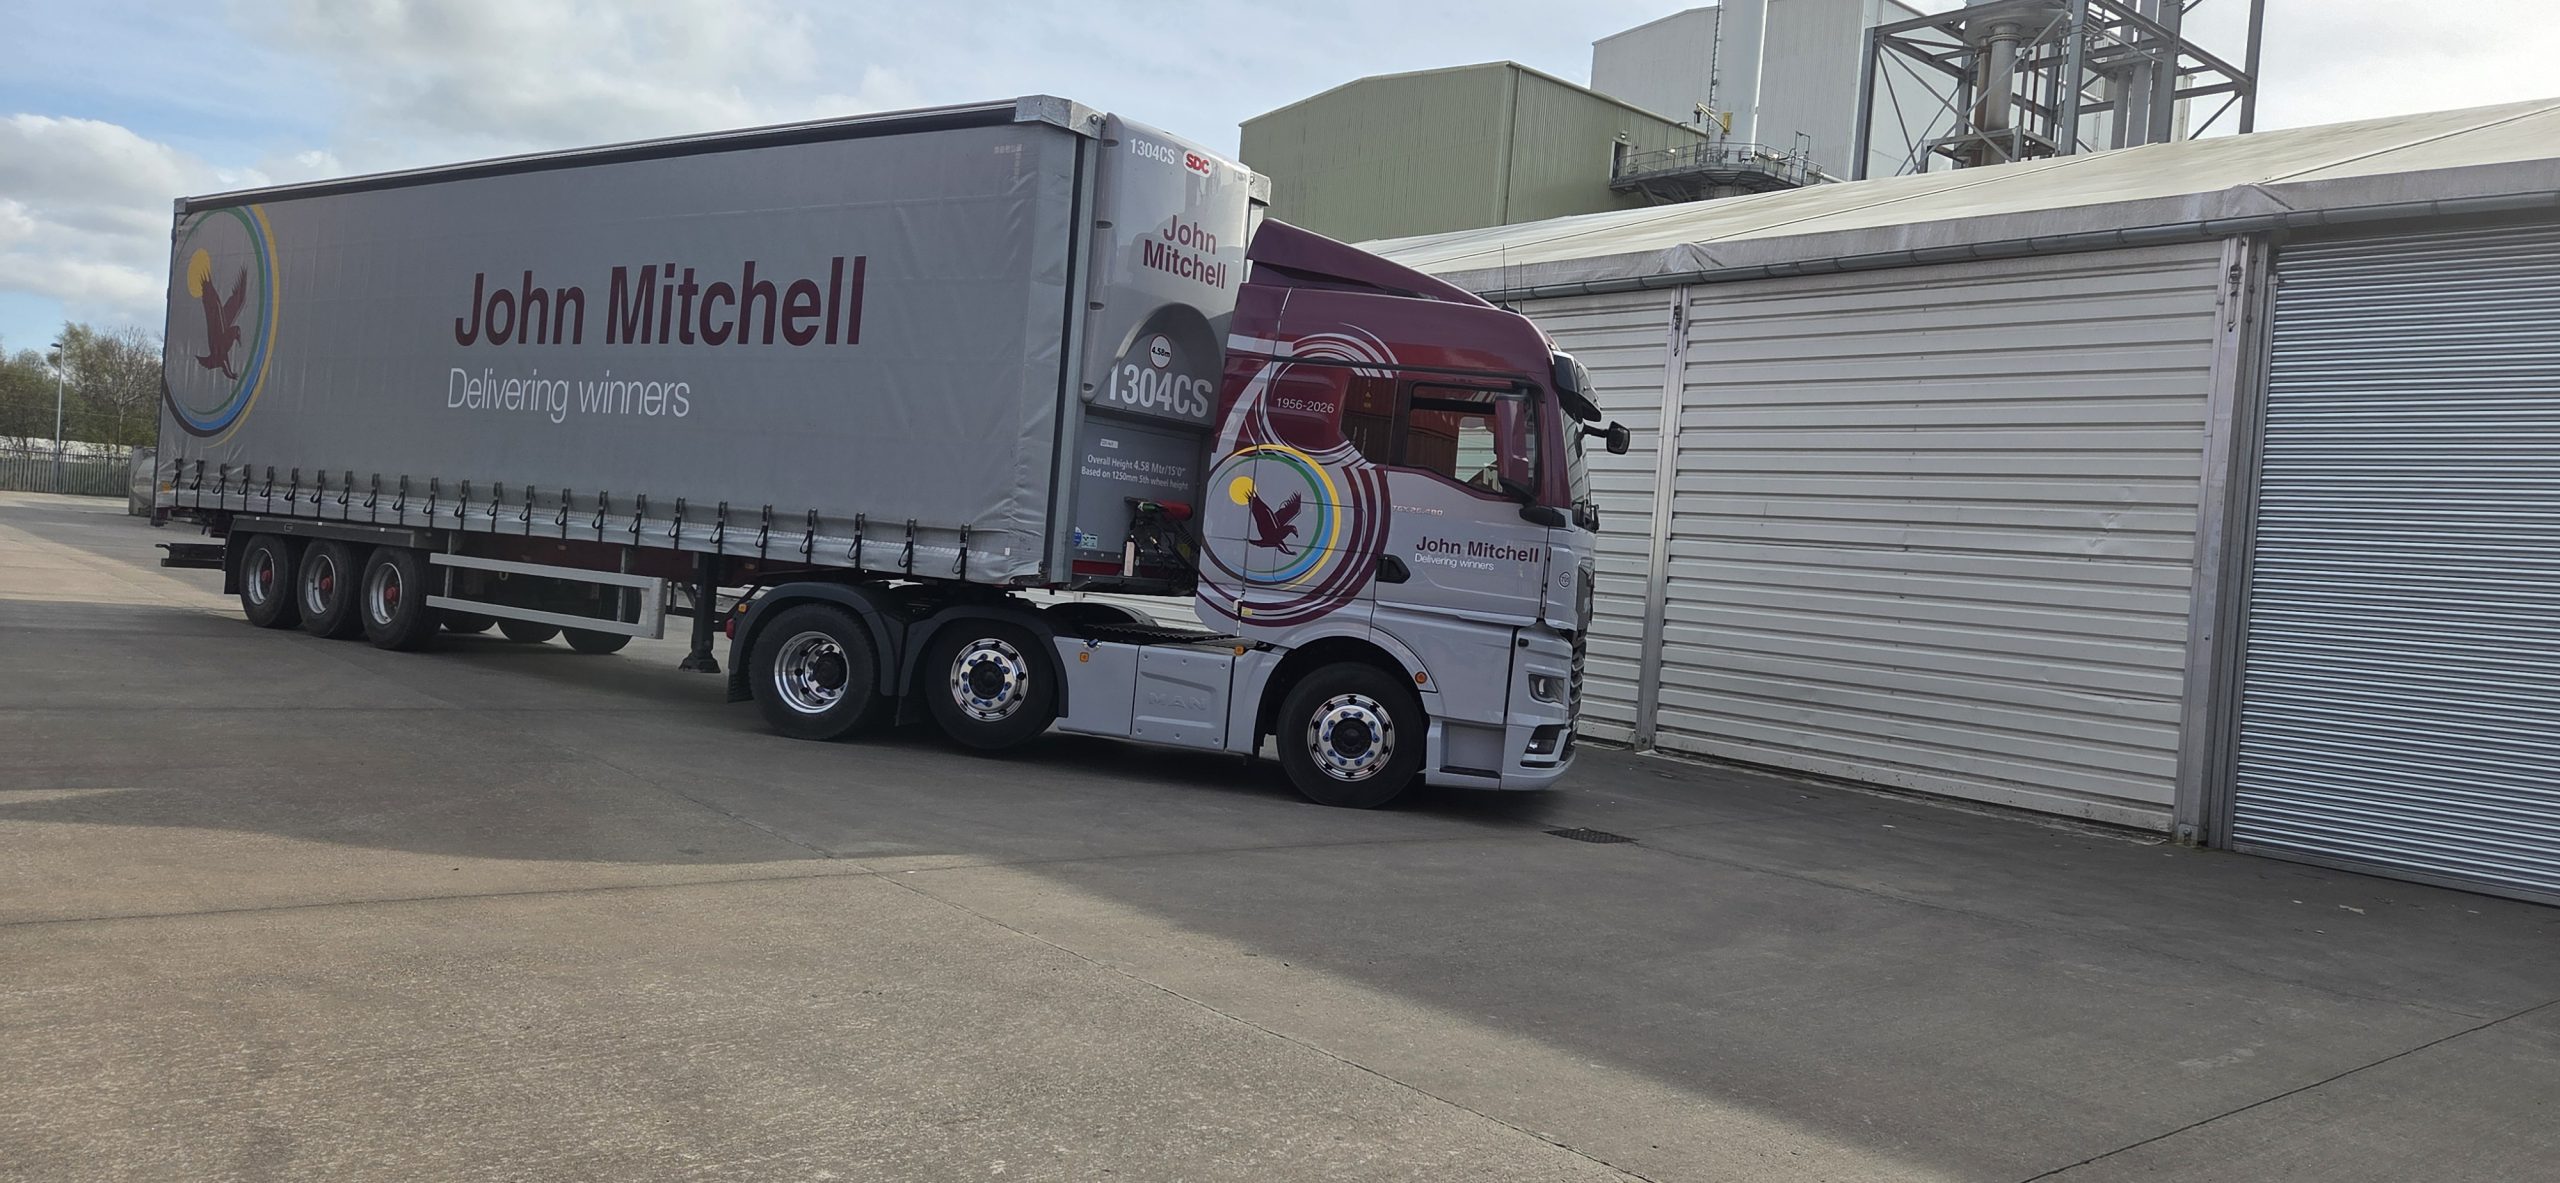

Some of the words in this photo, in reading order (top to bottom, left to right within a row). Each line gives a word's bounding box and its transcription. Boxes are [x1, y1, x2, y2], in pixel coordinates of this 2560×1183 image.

[1130, 138, 1175, 165] 1304CS
[1185, 153, 1210, 174] SDC
[1163, 214, 1217, 255] John
[1143, 239, 1227, 290] Mitchell
[454, 270, 585, 347] John
[605, 256, 867, 347] Mitchell
[1151, 346, 1171, 358] 4.58m
[447, 367, 570, 424] Delivering
[578, 370, 691, 418] winners
[1109, 361, 1213, 418] 1304CS
[1276, 397, 1335, 414] 1956-2026
[1081, 466, 1101, 477] Based
[1102, 470, 1111, 479] on
[1112, 471, 1138, 482] 1250mm
[1139, 474, 1150, 484] 5th
[1150, 476, 1169, 487] wheel
[1170, 479, 1189, 491] height
[1087, 454, 1111, 466] Overall
[1112, 457, 1133, 470] Height
[1133, 460, 1150, 472] 4.58
[1414, 553, 1457, 569] Delivering
[1459, 559, 1495, 571] winners
[1416, 536, 1461, 555] John
[1467, 541, 1539, 563] Mitchell
